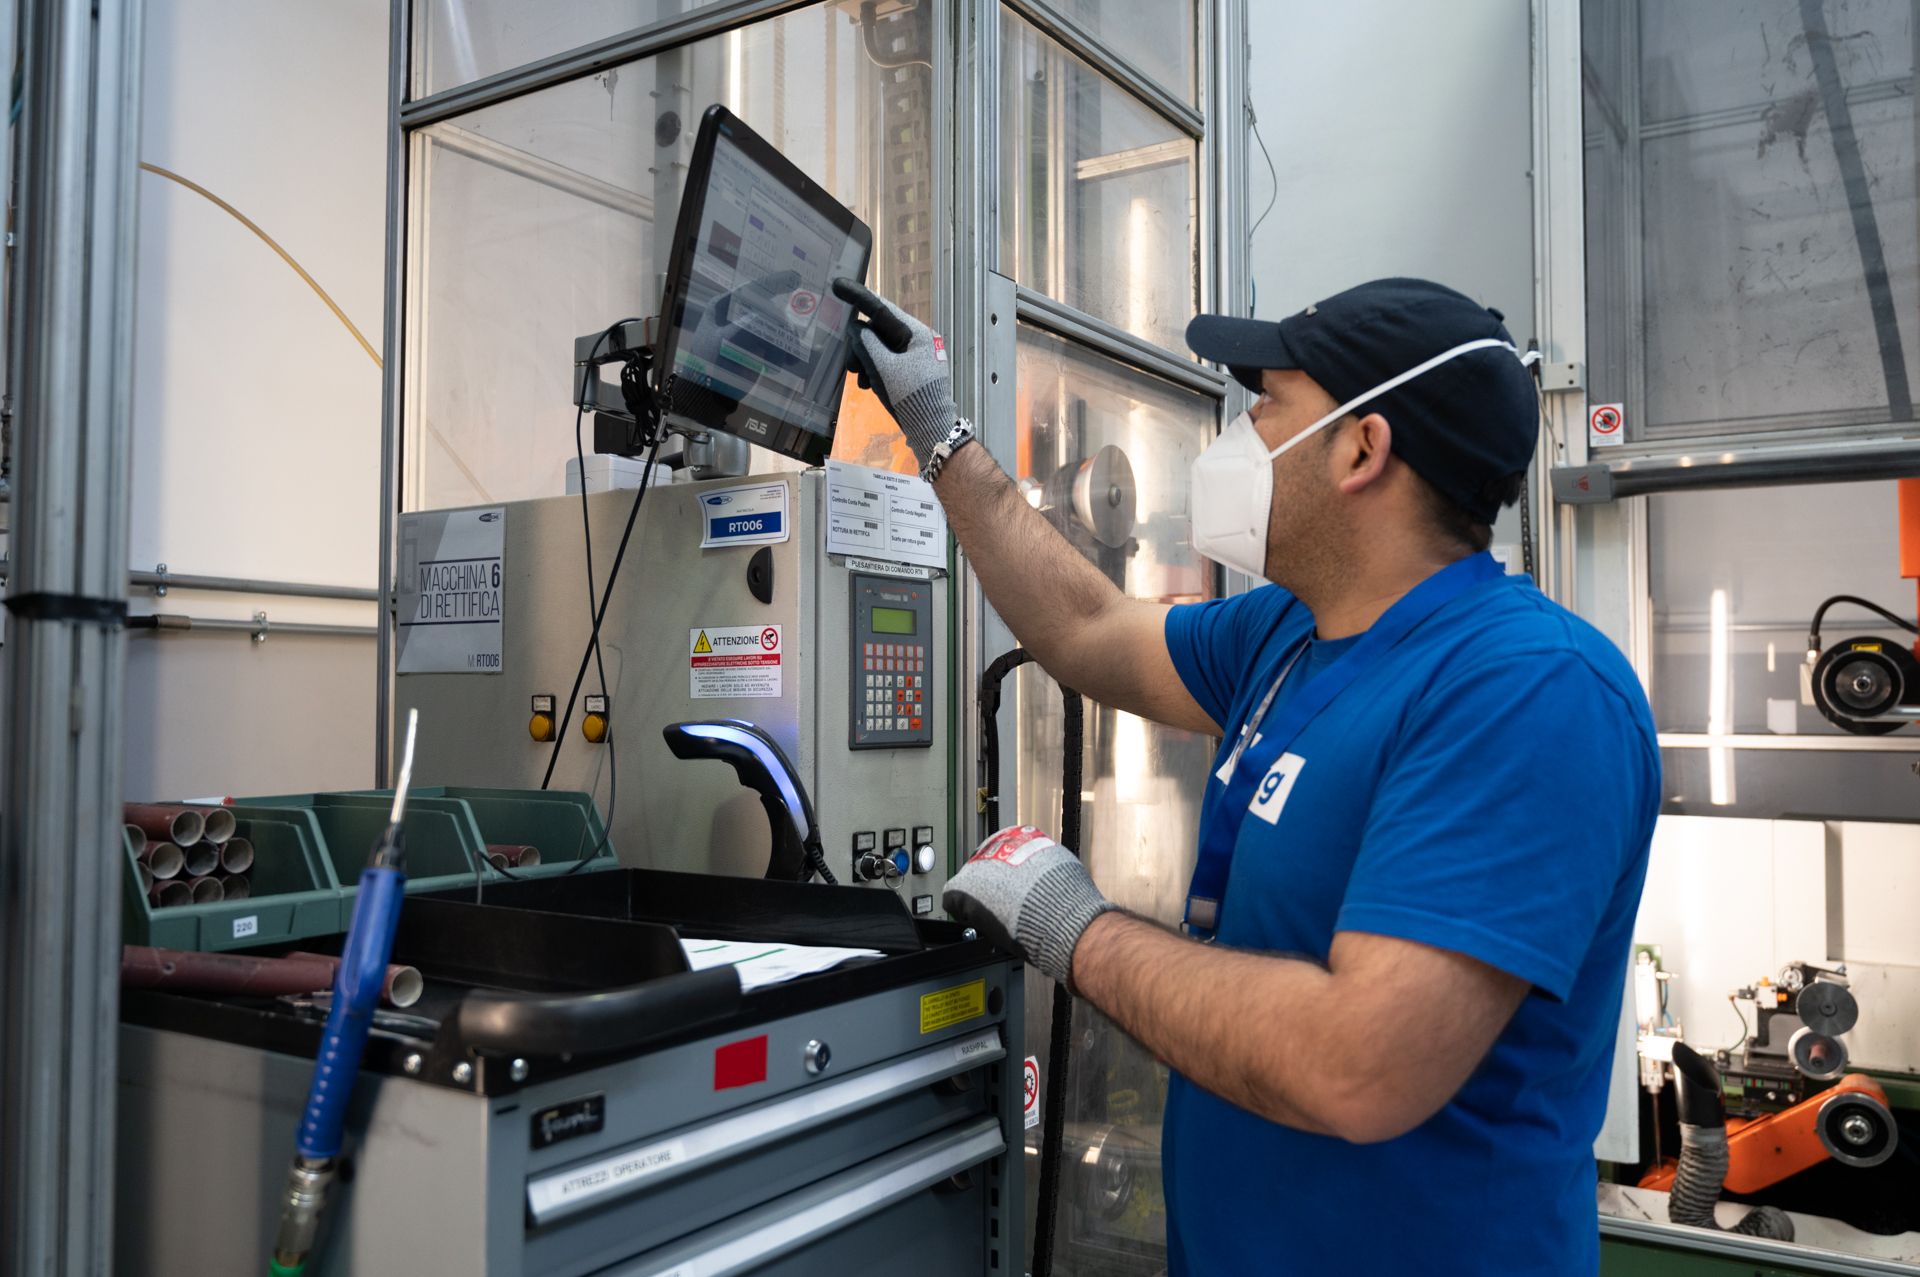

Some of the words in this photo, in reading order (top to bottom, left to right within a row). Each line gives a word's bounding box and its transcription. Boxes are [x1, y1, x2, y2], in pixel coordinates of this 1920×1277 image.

[744, 417, 768, 435] ASUS
[728, 519, 763, 533] RT006
[420, 563, 487, 593] MACCHINA
[491, 562, 500, 589] 6
[420, 593, 432, 619] DI
[435, 590, 500, 619] RETTIFICA
[712, 635, 760, 646] ATTENZIONE
[476, 653, 500, 668] RT006
[235, 920, 254, 933] 220
[961, 1039, 989, 1056] RASHPAL
[612, 1149, 673, 1179] OPERATORE
